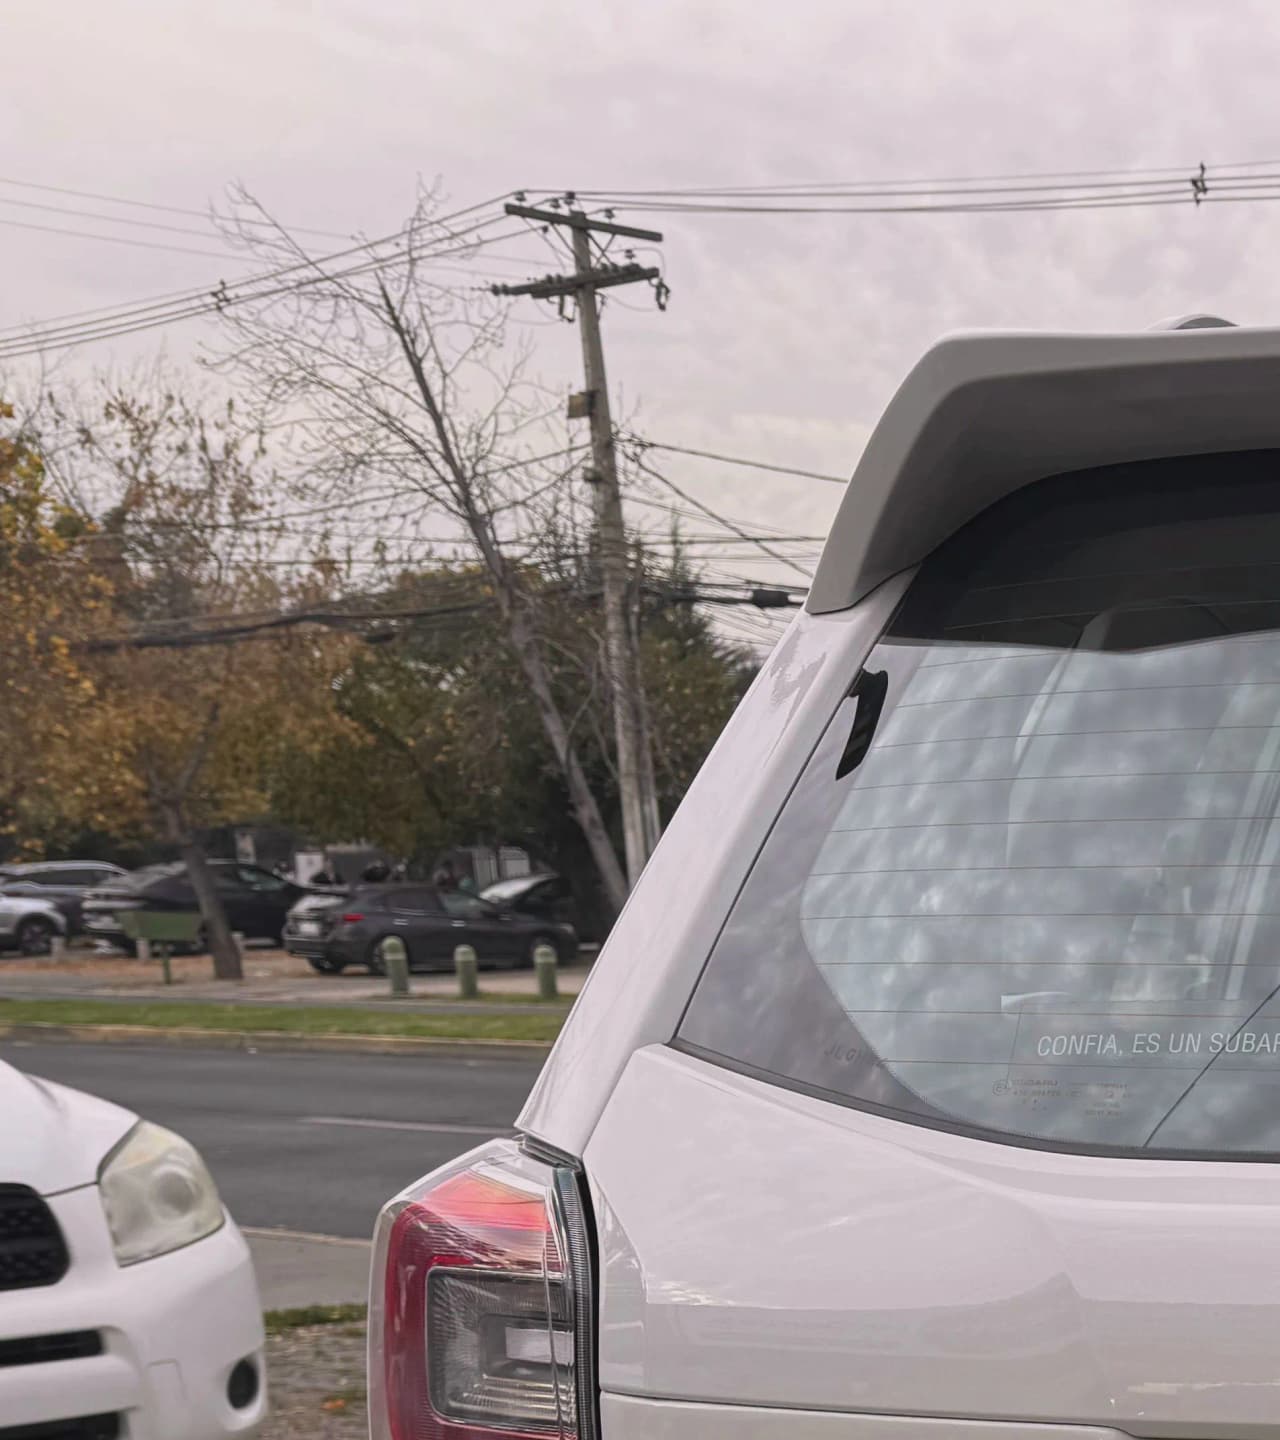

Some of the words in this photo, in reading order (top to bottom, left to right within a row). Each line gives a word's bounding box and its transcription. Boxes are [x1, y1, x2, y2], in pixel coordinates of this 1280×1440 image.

[1037, 1034, 1123, 1056] CONFIA,
[1132, 1033, 1161, 1054] ES
[1168, 1033, 1201, 1054] UN
